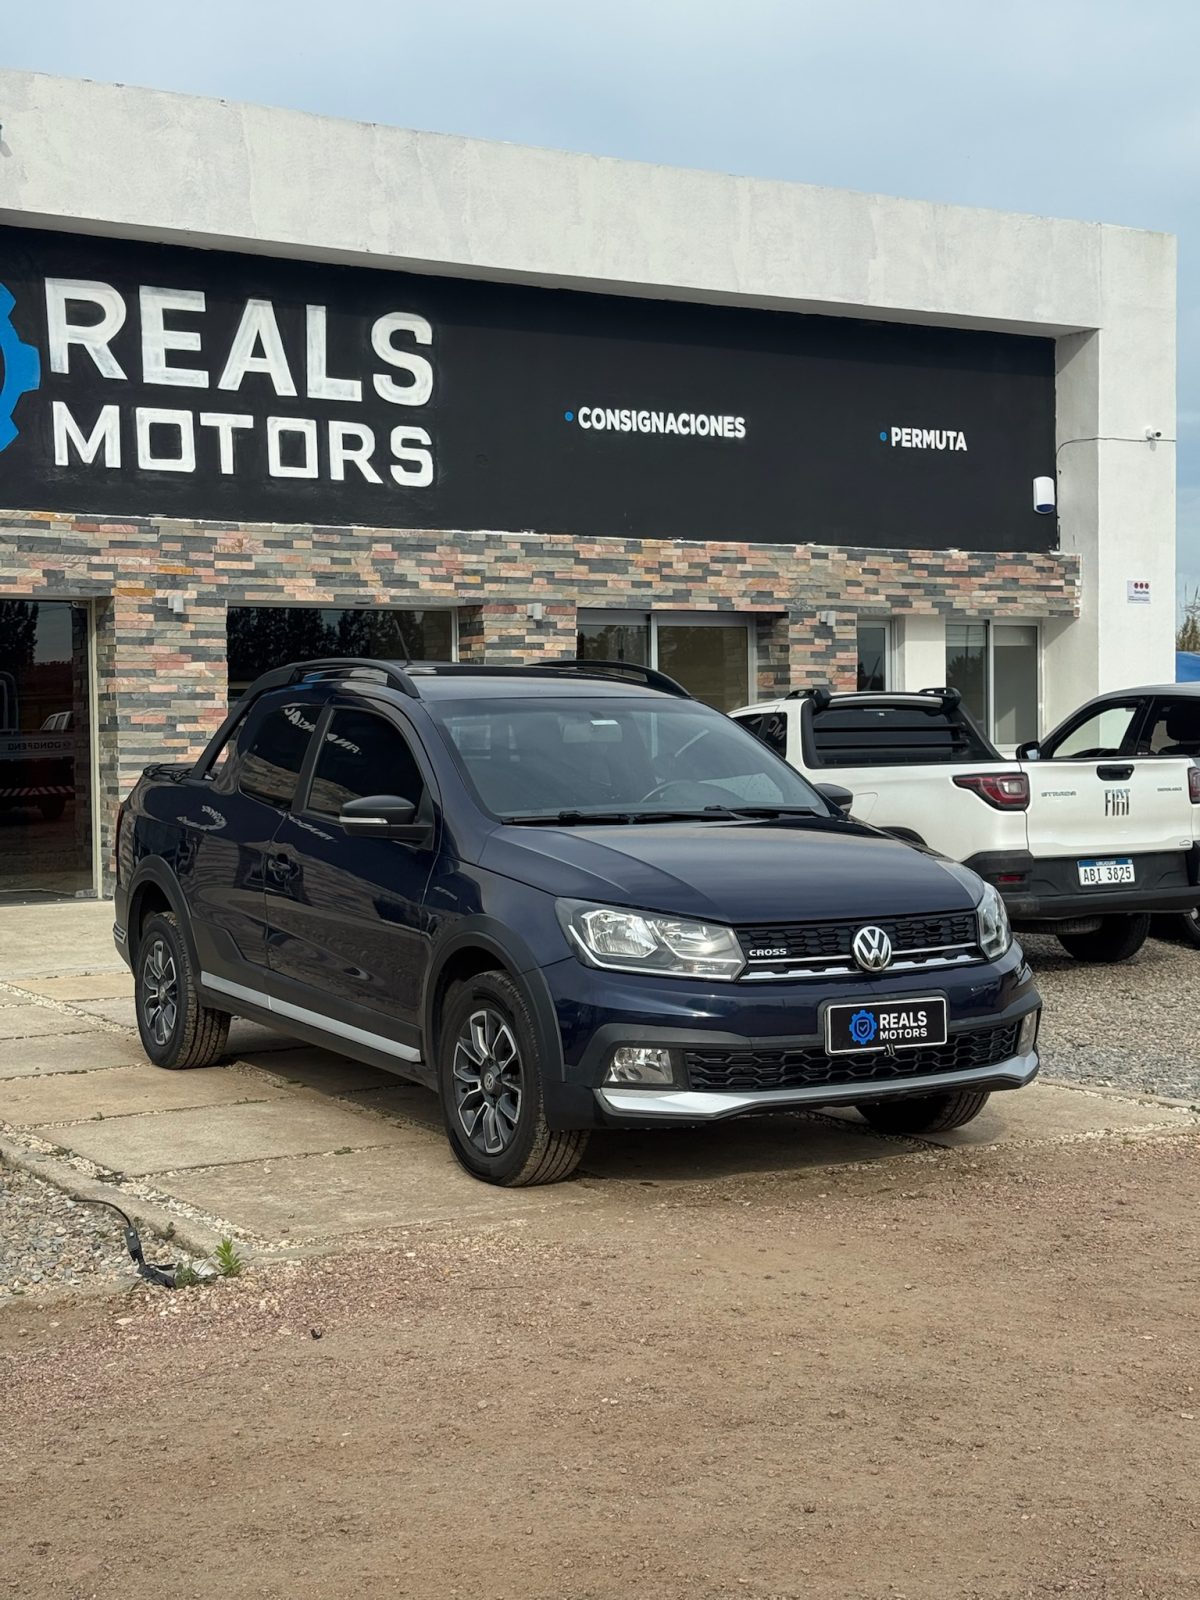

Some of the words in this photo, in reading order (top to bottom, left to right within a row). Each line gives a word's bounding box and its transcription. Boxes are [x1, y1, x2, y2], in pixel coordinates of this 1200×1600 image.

[44, 277, 434, 407] REALS
[578, 407, 746, 438] CONSIGNACIONES
[51, 401, 435, 488] MOTORS
[890, 426, 968, 452] PERMUTA
[1104, 788, 1130, 816] FIAT
[1083, 868, 1102, 883] ABI
[1106, 866, 1132, 881] 3825
[749, 948, 787, 957] CROSS
[879, 1011, 927, 1029] REALS
[880, 1027, 928, 1041] MOTORS
